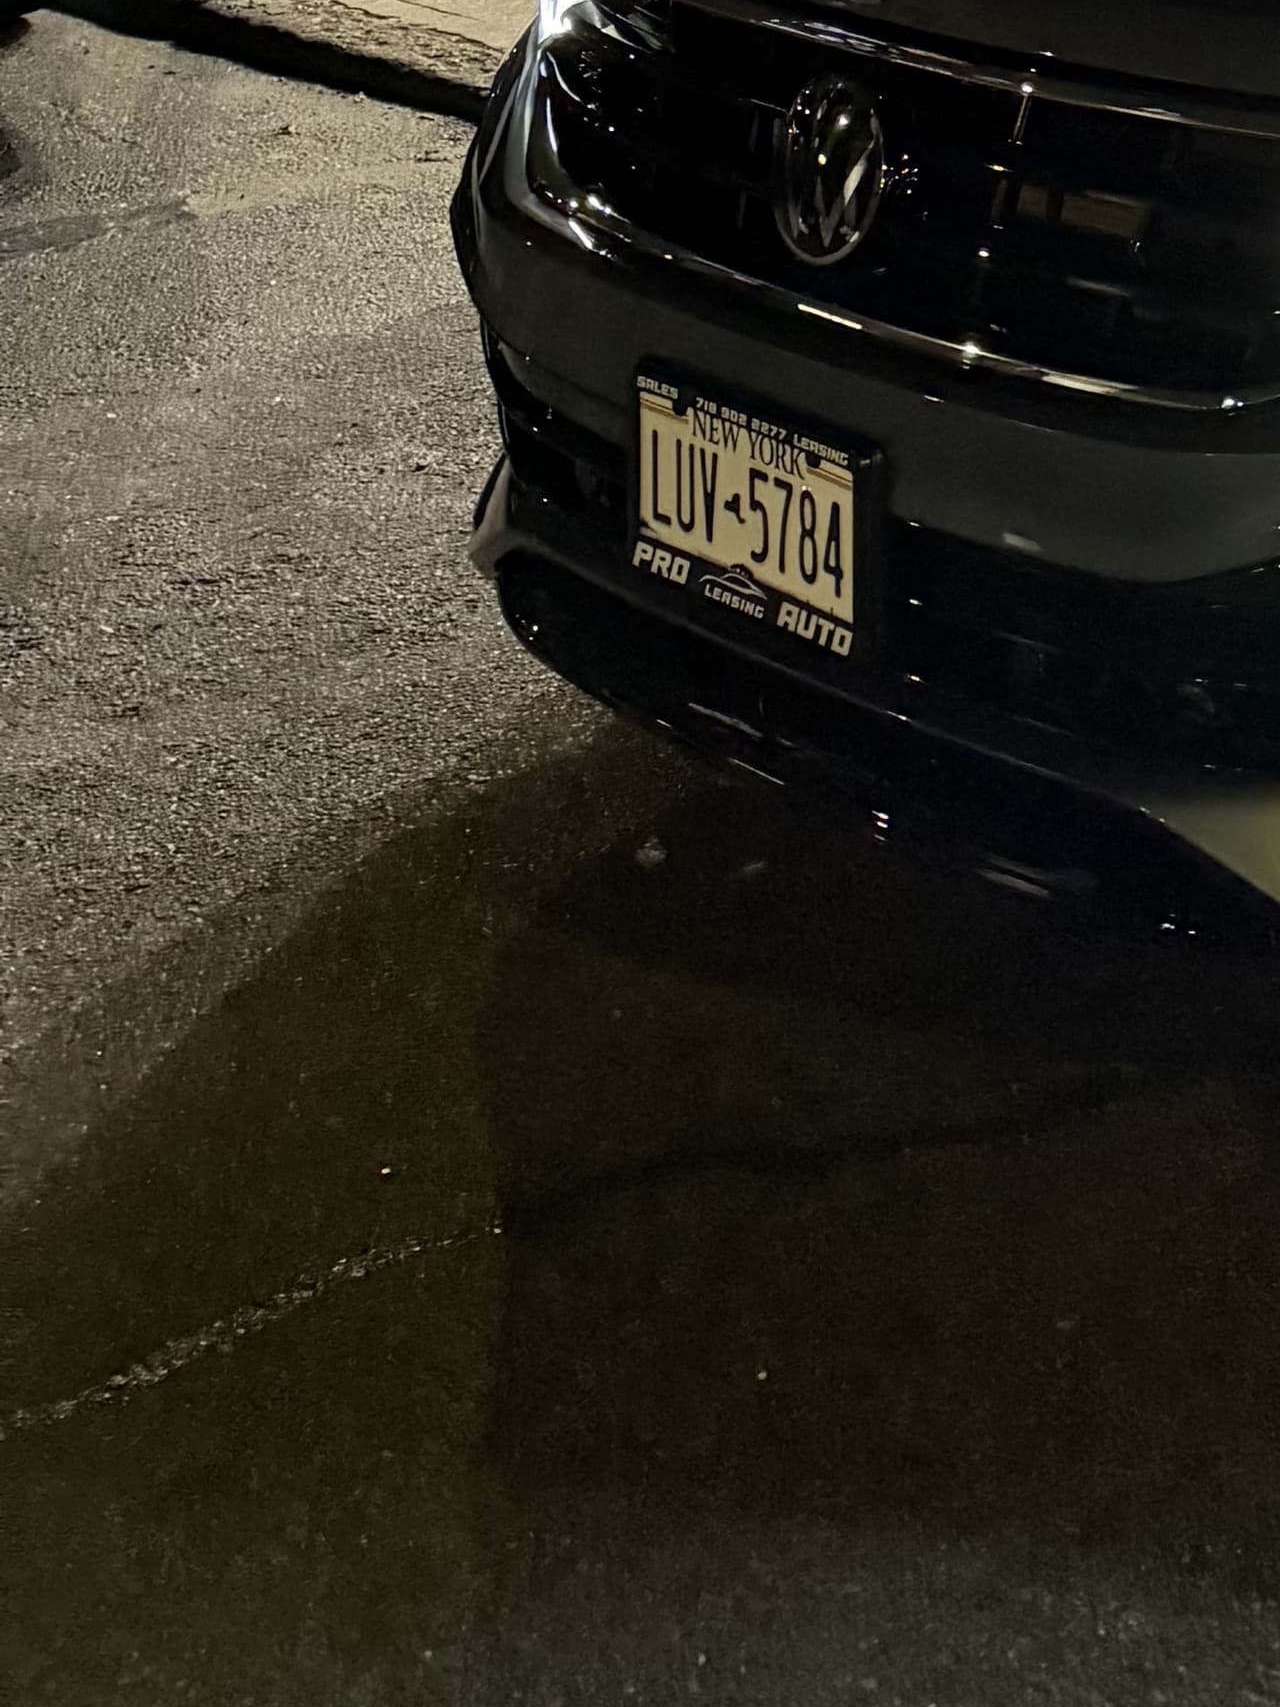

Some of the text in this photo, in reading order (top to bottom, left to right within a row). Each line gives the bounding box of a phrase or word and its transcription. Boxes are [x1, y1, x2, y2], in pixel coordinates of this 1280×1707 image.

[636, 376, 679, 399] SALES
[691, 410, 805, 480] NEW YORK
[695, 397, 849, 466] 718 902 2277 LEASING
[632, 541, 853, 657] PRO AUTO
[704, 583, 766, 619] LEASING
